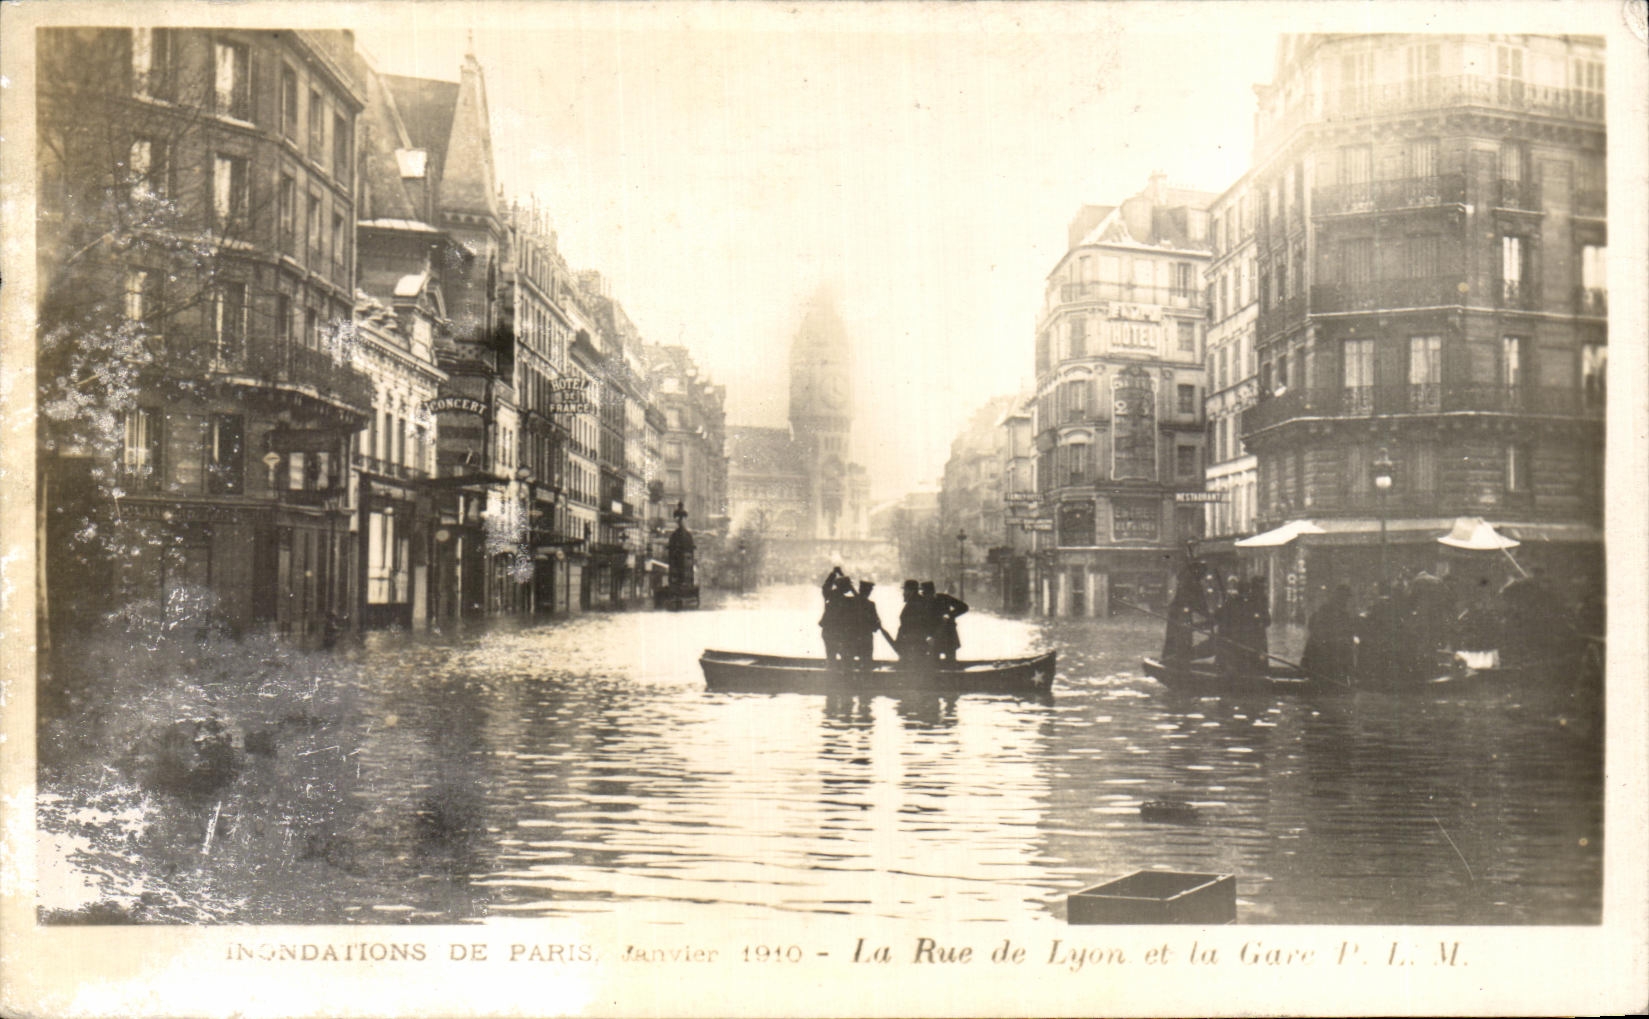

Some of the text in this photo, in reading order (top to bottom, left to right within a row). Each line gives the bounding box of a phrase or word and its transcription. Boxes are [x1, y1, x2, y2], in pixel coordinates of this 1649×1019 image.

[551, 378, 588, 391] HOTEL
[430, 398, 488, 414] CONCERT
[550, 403, 590, 413] FRANCE
